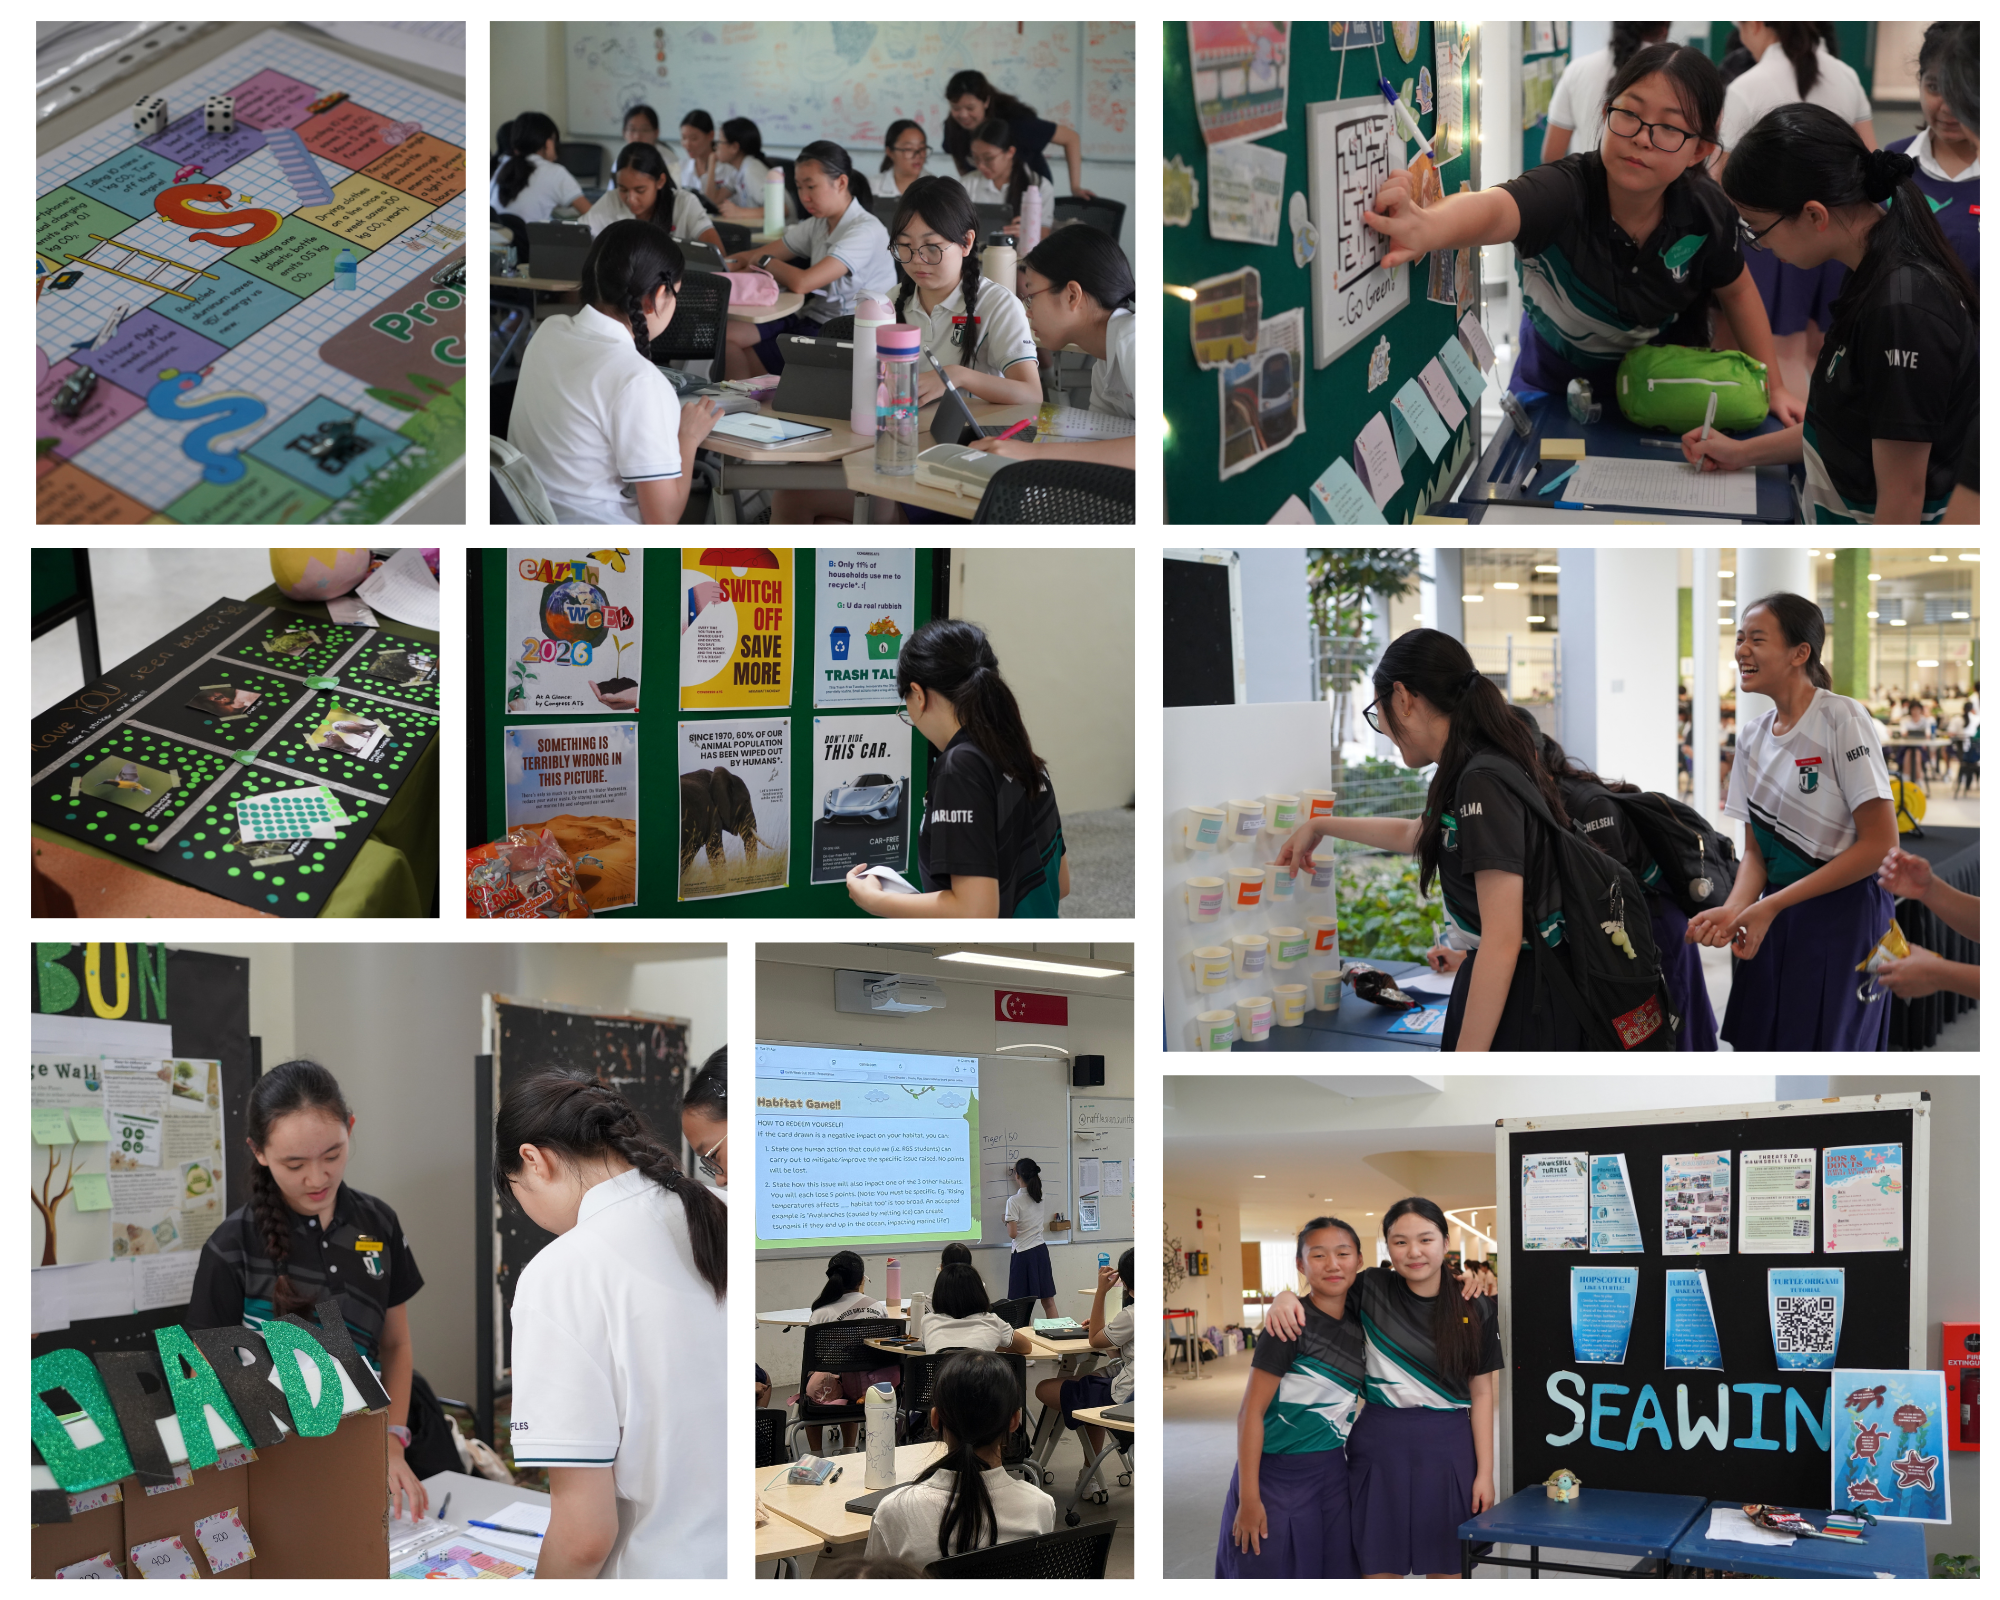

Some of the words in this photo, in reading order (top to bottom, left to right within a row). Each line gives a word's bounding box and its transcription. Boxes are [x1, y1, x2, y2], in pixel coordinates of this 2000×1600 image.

[315, 204, 346, 223] Drying
[343, 187, 371, 205] clothes
[331, 219, 344, 228] on
[349, 204, 361, 216] line
[362, 194, 381, 208] once
[344, 217, 366, 233] week
[365, 205, 388, 220] saves
[386, 195, 401, 207] 100
[355, 229, 371, 240] kg
[249, 244, 283, 265] Making
[281, 234, 297, 246] one
[265, 252, 294, 272] plastic
[289, 235, 318, 254] bottle
[280, 261, 303, 277] emits
[313, 243, 330, 253] kg
[1346, 291, 1364, 325] Go
[828, 560, 837, 568] B:
[837, 561, 855, 570] Only
[856, 561, 869, 569] 11%
[828, 570, 869, 579] households
[719, 577, 783, 604] SWITCH
[836, 601, 845, 609] G:
[863, 602, 877, 610] real
[877, 602, 902, 610] rubbish
[753, 606, 783, 631] OFF
[521, 636, 593, 667] 2026
[740, 634, 782, 659] SAVE
[733, 661, 781, 686] MORE
[824, 669, 869, 681] TRASH
[871, 668, 897, 680] TAL
[59, 682, 122, 715] YOU
[130, 651, 175, 681] seen
[535, 700, 543, 708] by
[88, 713, 113, 730] sticker
[116, 703, 130, 713] and
[688, 732, 714, 742] SINCE
[715, 731, 735, 741] 1970,
[736, 731, 755, 740] 60%
[755, 730, 766, 738] OF
[766, 729, 783, 738] OUR
[824, 734, 846, 744] DON'T
[847, 733, 864, 743] RIDE
[537, 737, 597, 753] SOMETHING
[598, 735, 609, 750] IS
[700, 741, 733, 751] ANIMAL
[733, 738, 783, 749] POPULATION
[700, 751, 718, 760] HAS
[719, 750, 739, 759] BEEN
[740, 748, 767, 758] WIPED
[767, 747, 784, 756] OUT
[824, 743, 855, 761] THIS
[860, 742, 892, 759] CAR.
[522, 754, 571, 771] TERRIBLY
[572, 752, 610, 768] WRONG
[611, 752, 622, 765] IN
[730, 759, 741, 767] BY
[538, 772, 562, 787] THIS
[563, 769, 608, 786] PICTURE.
[869, 835, 900, 846] CAR-FREE
[886, 843, 900, 852] DAY
[504, 889, 554, 919] Crackers
[54, 1063, 97, 1080] Wall
[756, 1097, 804, 1109] Habitat
[827, 1132, 855, 1140] negative
[856, 1132, 877, 1140] impact
[982, 1134, 1003, 1146] Tiger
[1008, 1132, 1018, 1142] 50
[1008, 1150, 1020, 1160] 50
[1826, 1155, 1848, 1163] DOS
[1849, 1154, 1857, 1162] &
[1541, 1166, 1568, 1174] TURTLES
[1579, 1276, 1631, 1284] HOPSCOTCH
[1669, 1279, 1695, 1287] TURTLE
[1773, 1278, 1804, 1286] TURTLE
[1804, 1278, 1839, 1286] ORIGAMI
[1545, 1369, 1831, 1453] SEAWIN
[212, 1531, 229, 1543] 500
[151, 1553, 171, 1567] 400
